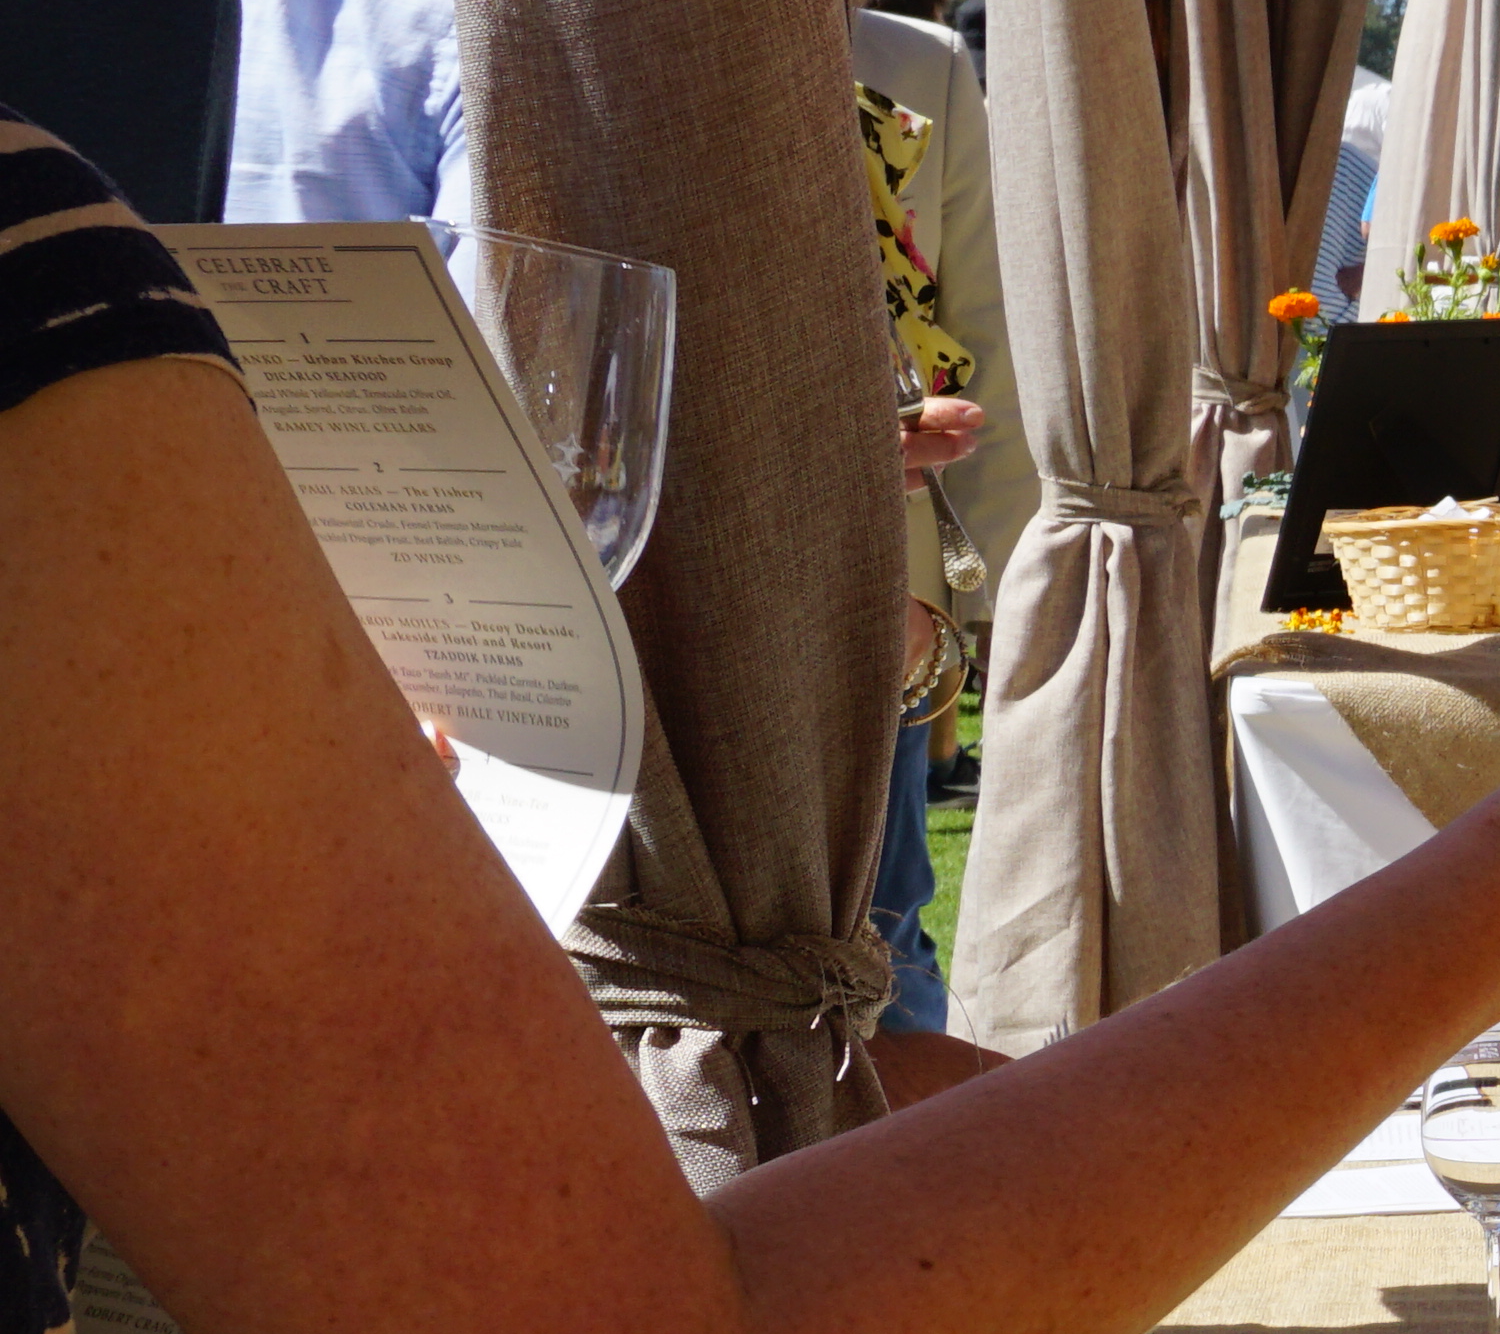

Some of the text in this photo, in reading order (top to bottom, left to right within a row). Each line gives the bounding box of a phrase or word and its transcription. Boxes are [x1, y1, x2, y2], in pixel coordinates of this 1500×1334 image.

[196, 256, 333, 274] CELEBRATE
[221, 278, 329, 295] THE CRAFT
[300, 332, 310, 345] 1
[240, 355, 453, 369] ANKO Urban Kitchen Group
[263, 371, 388, 382] DICARLO SEAFOOD
[273, 422, 437, 434] RAMEY WINE CELLARS
[373, 461, 384, 474] 2
[298, 484, 483, 501] PAUL ARIAS The Fishery
[345, 502, 456, 514] COLEMAN FARMS
[391, 552, 464, 565] ZD WINES
[443, 593, 454, 605] 3
[398, 617, 450, 629] MOILES
[470, 620, 510, 636] Decoy
[515, 622, 580, 640] Dockside,
[381, 630, 552, 652] Lakeside Hotel and Resort
[424, 650, 524, 667] TZADDIK FARMS
[400, 667, 422, 678] Taco
[475, 673, 507, 686] Pickled
[398, 680, 440, 693] ucumber,
[488, 689, 508, 700] Thai
[411, 700, 570, 729] OBERT BIALE VINEYARDS
[84, 1305, 133, 1324] ROBERT
